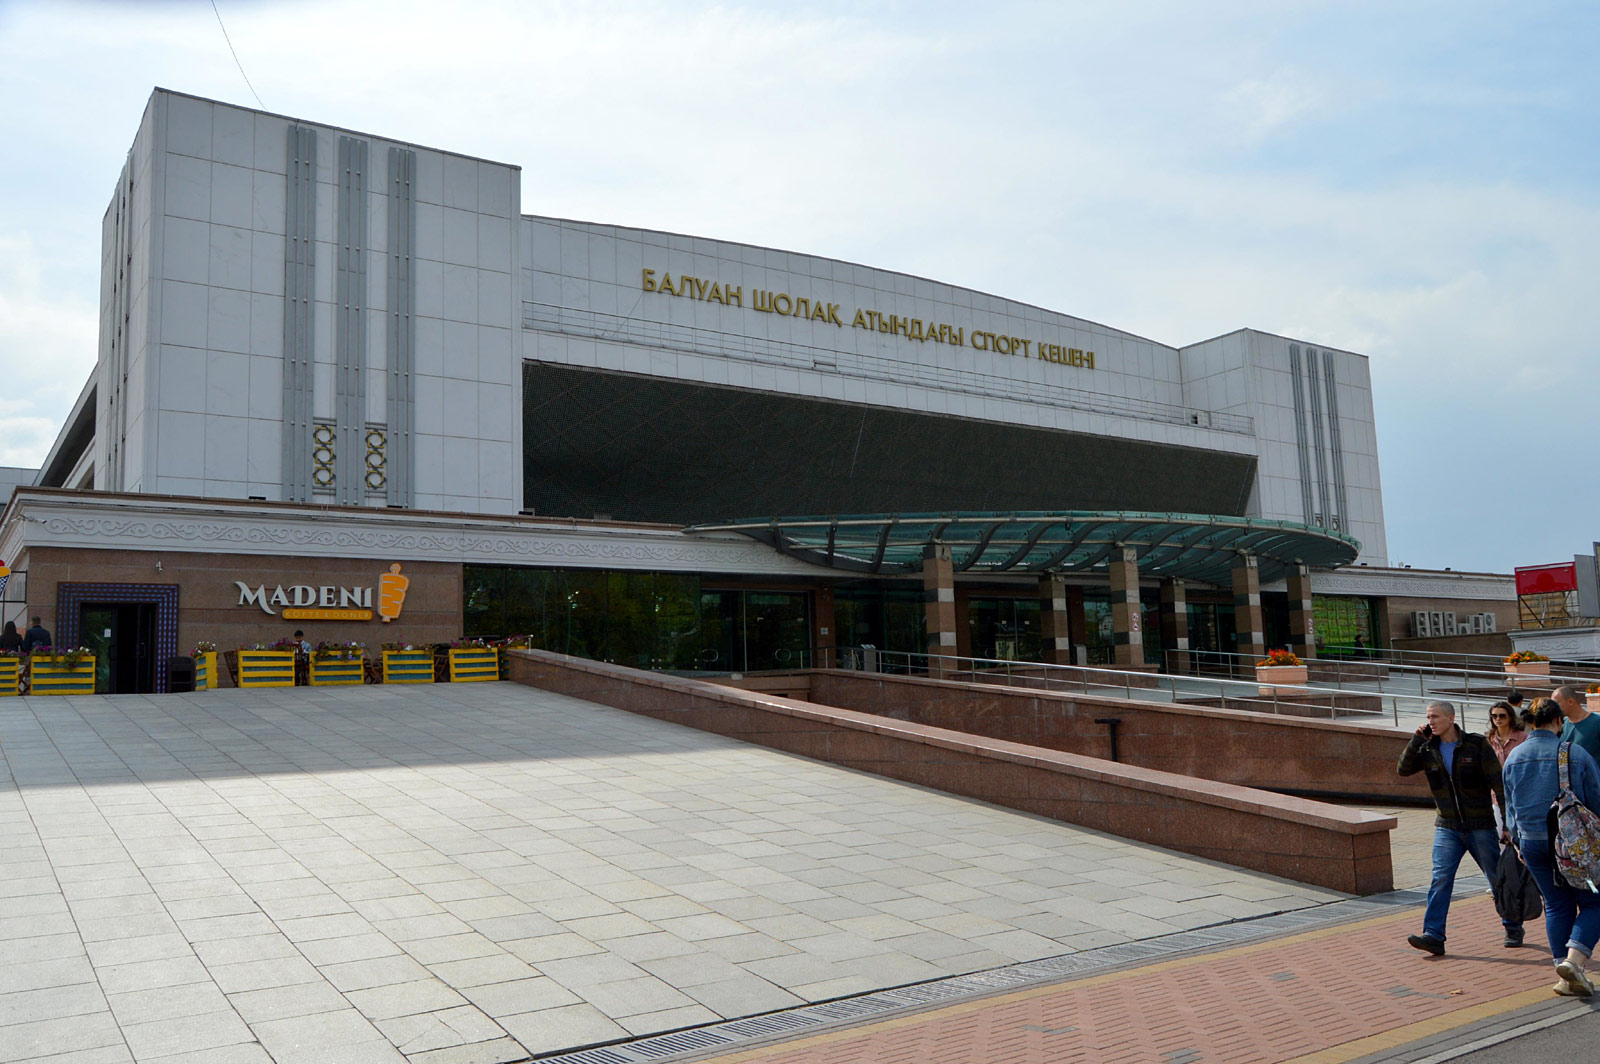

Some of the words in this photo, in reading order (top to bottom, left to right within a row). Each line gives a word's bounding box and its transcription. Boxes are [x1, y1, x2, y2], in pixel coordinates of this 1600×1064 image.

[642, 268, 743, 308] БАЛУАН
[753, 288, 842, 327] ШОЛАҚ
[852, 308, 965, 346] АТЫНДАҒЫ
[971, 330, 1032, 358] СПОРТ
[1038, 341, 1096, 369] КЕШЕНІ
[234, 581, 373, 615] MADENI
